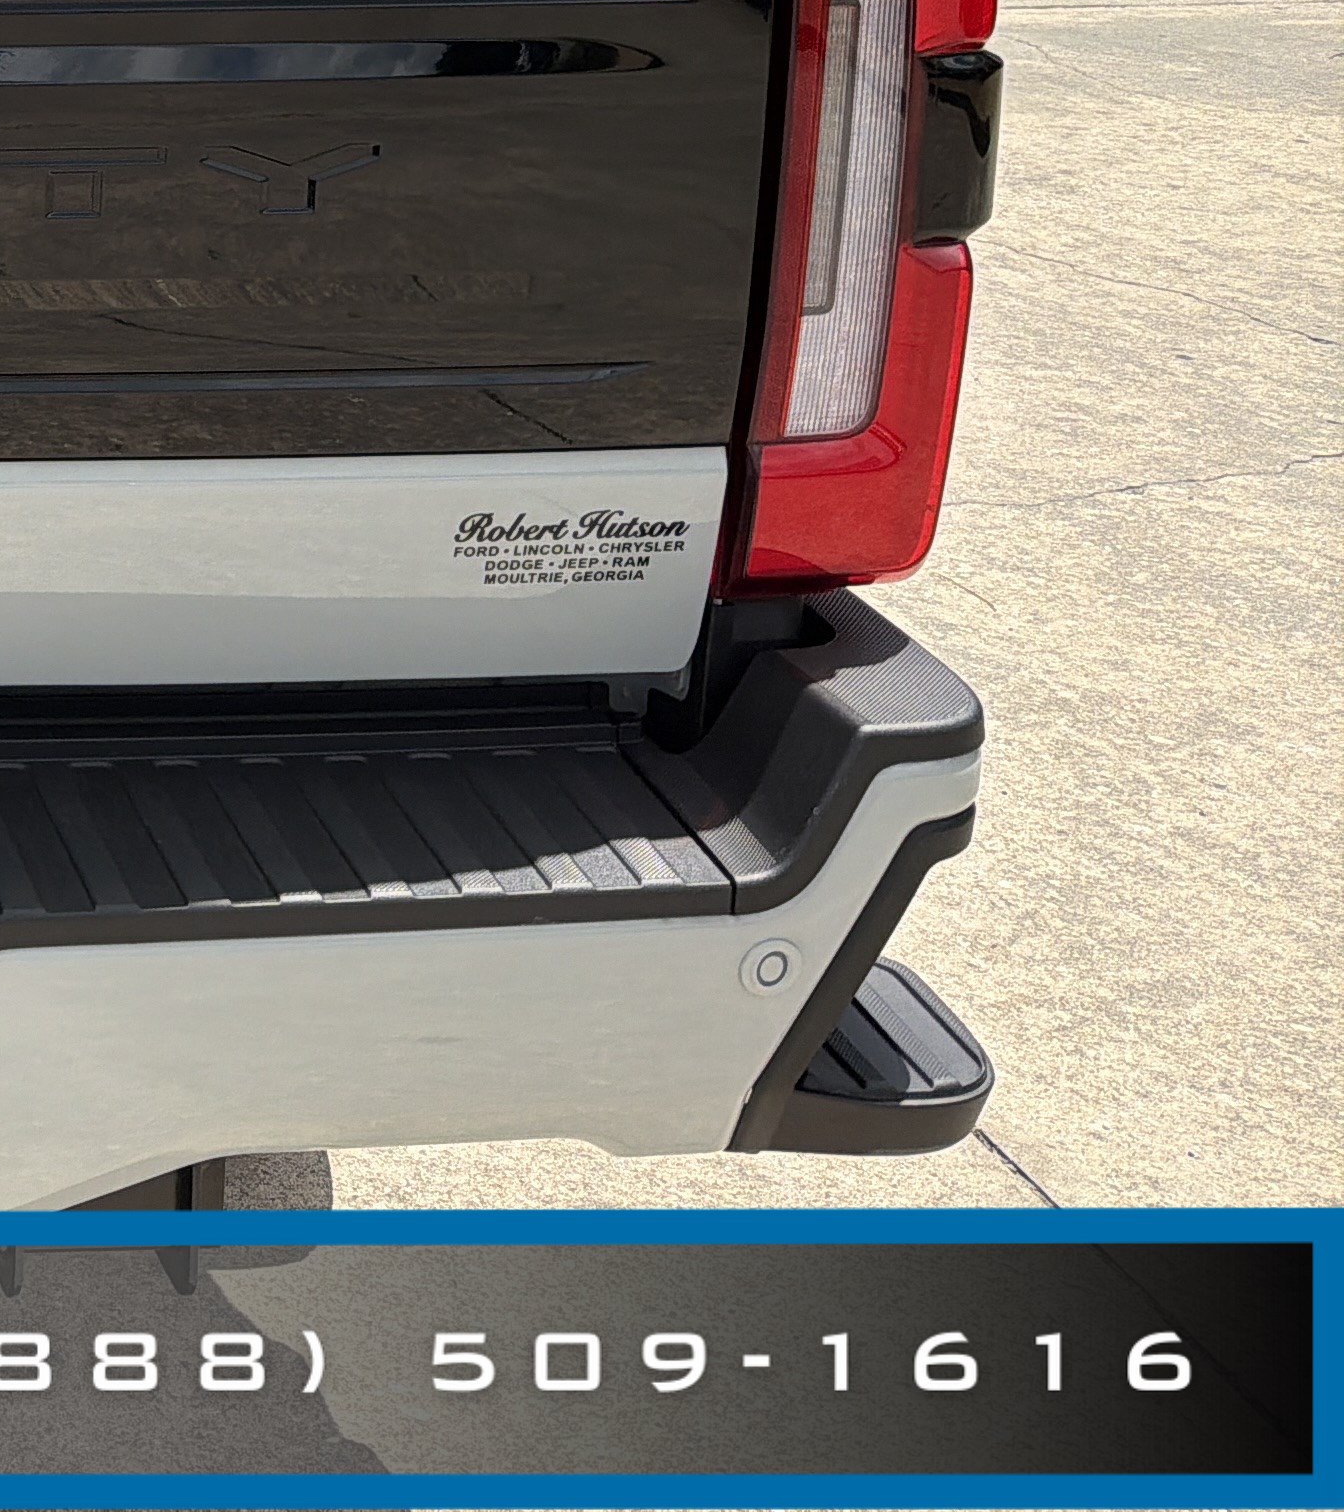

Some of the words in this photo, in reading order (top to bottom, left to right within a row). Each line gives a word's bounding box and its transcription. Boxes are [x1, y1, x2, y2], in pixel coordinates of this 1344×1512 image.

[452, 511, 570, 544] Robert
[572, 508, 691, 541] Hutson
[453, 545, 500, 558] FORD
[513, 543, 585, 556] LINCOLN
[598, 539, 685, 555] CHRYSLER
[484, 559, 544, 572] DODGE
[558, 557, 600, 570] JEEP
[611, 555, 650, 568] RAM
[483, 571, 569, 586] MOULTRIE,
[571, 569, 645, 583] GEORGIA
